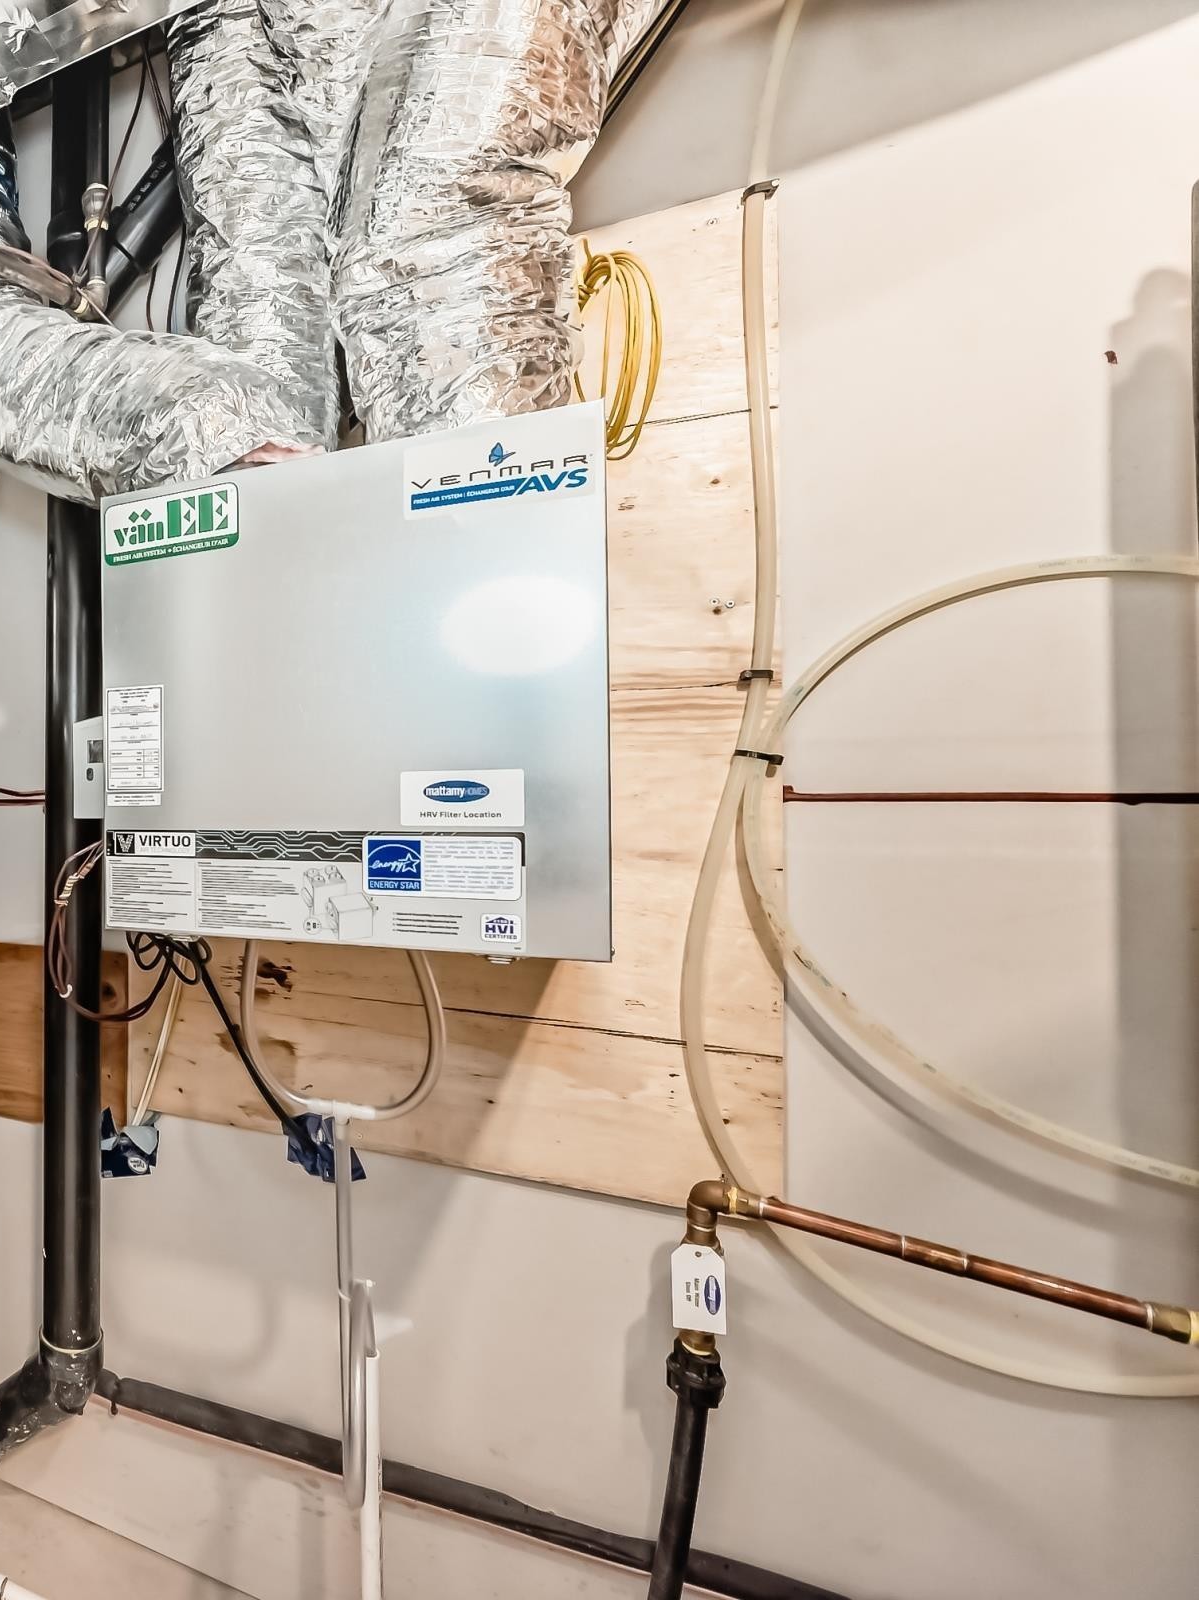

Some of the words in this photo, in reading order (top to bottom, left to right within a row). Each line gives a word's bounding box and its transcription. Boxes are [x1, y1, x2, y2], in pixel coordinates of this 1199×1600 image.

[516, 468, 589, 496] AVS
[139, 834, 191, 847] VIRTUO
[369, 880, 399, 889] ENERGY
[400, 881, 420, 890] STAR
